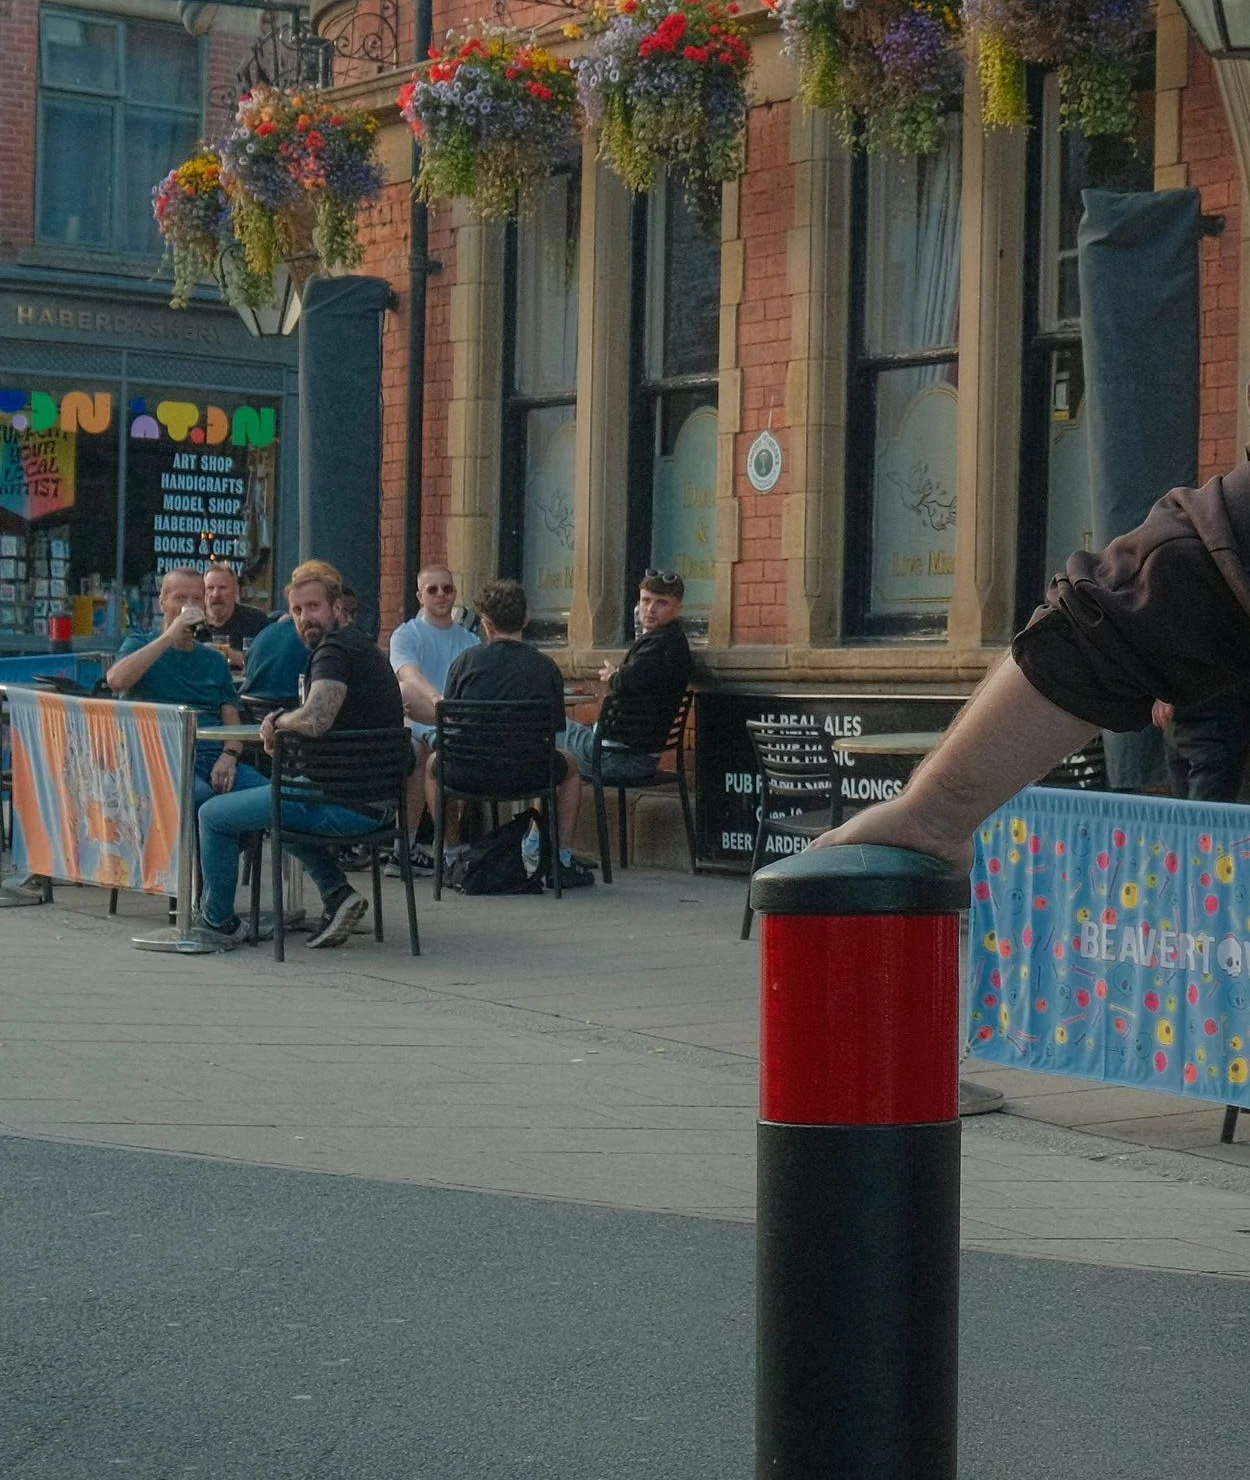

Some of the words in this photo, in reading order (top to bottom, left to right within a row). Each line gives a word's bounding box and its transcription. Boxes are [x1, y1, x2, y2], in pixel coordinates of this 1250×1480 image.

[173, 452, 196, 470] ART
[200, 454, 233, 472] SHOP
[161, 472, 243, 495] HANDICRAFTS
[163, 494, 205, 513] MODEL
[208, 497, 241, 515] SHOP
[154, 515, 248, 536] HABERDASHERY
[154, 536, 194, 554] BOOKS
[198, 539, 209, 555] &
[212, 539, 247, 557] GIFTS
[824, 715, 862, 737] ALES
[725, 772, 753, 794] PUB
[841, 778, 902, 800] ALONGS
[722, 831, 753, 851] BEER
[765, 834, 812, 854] ARDEN
